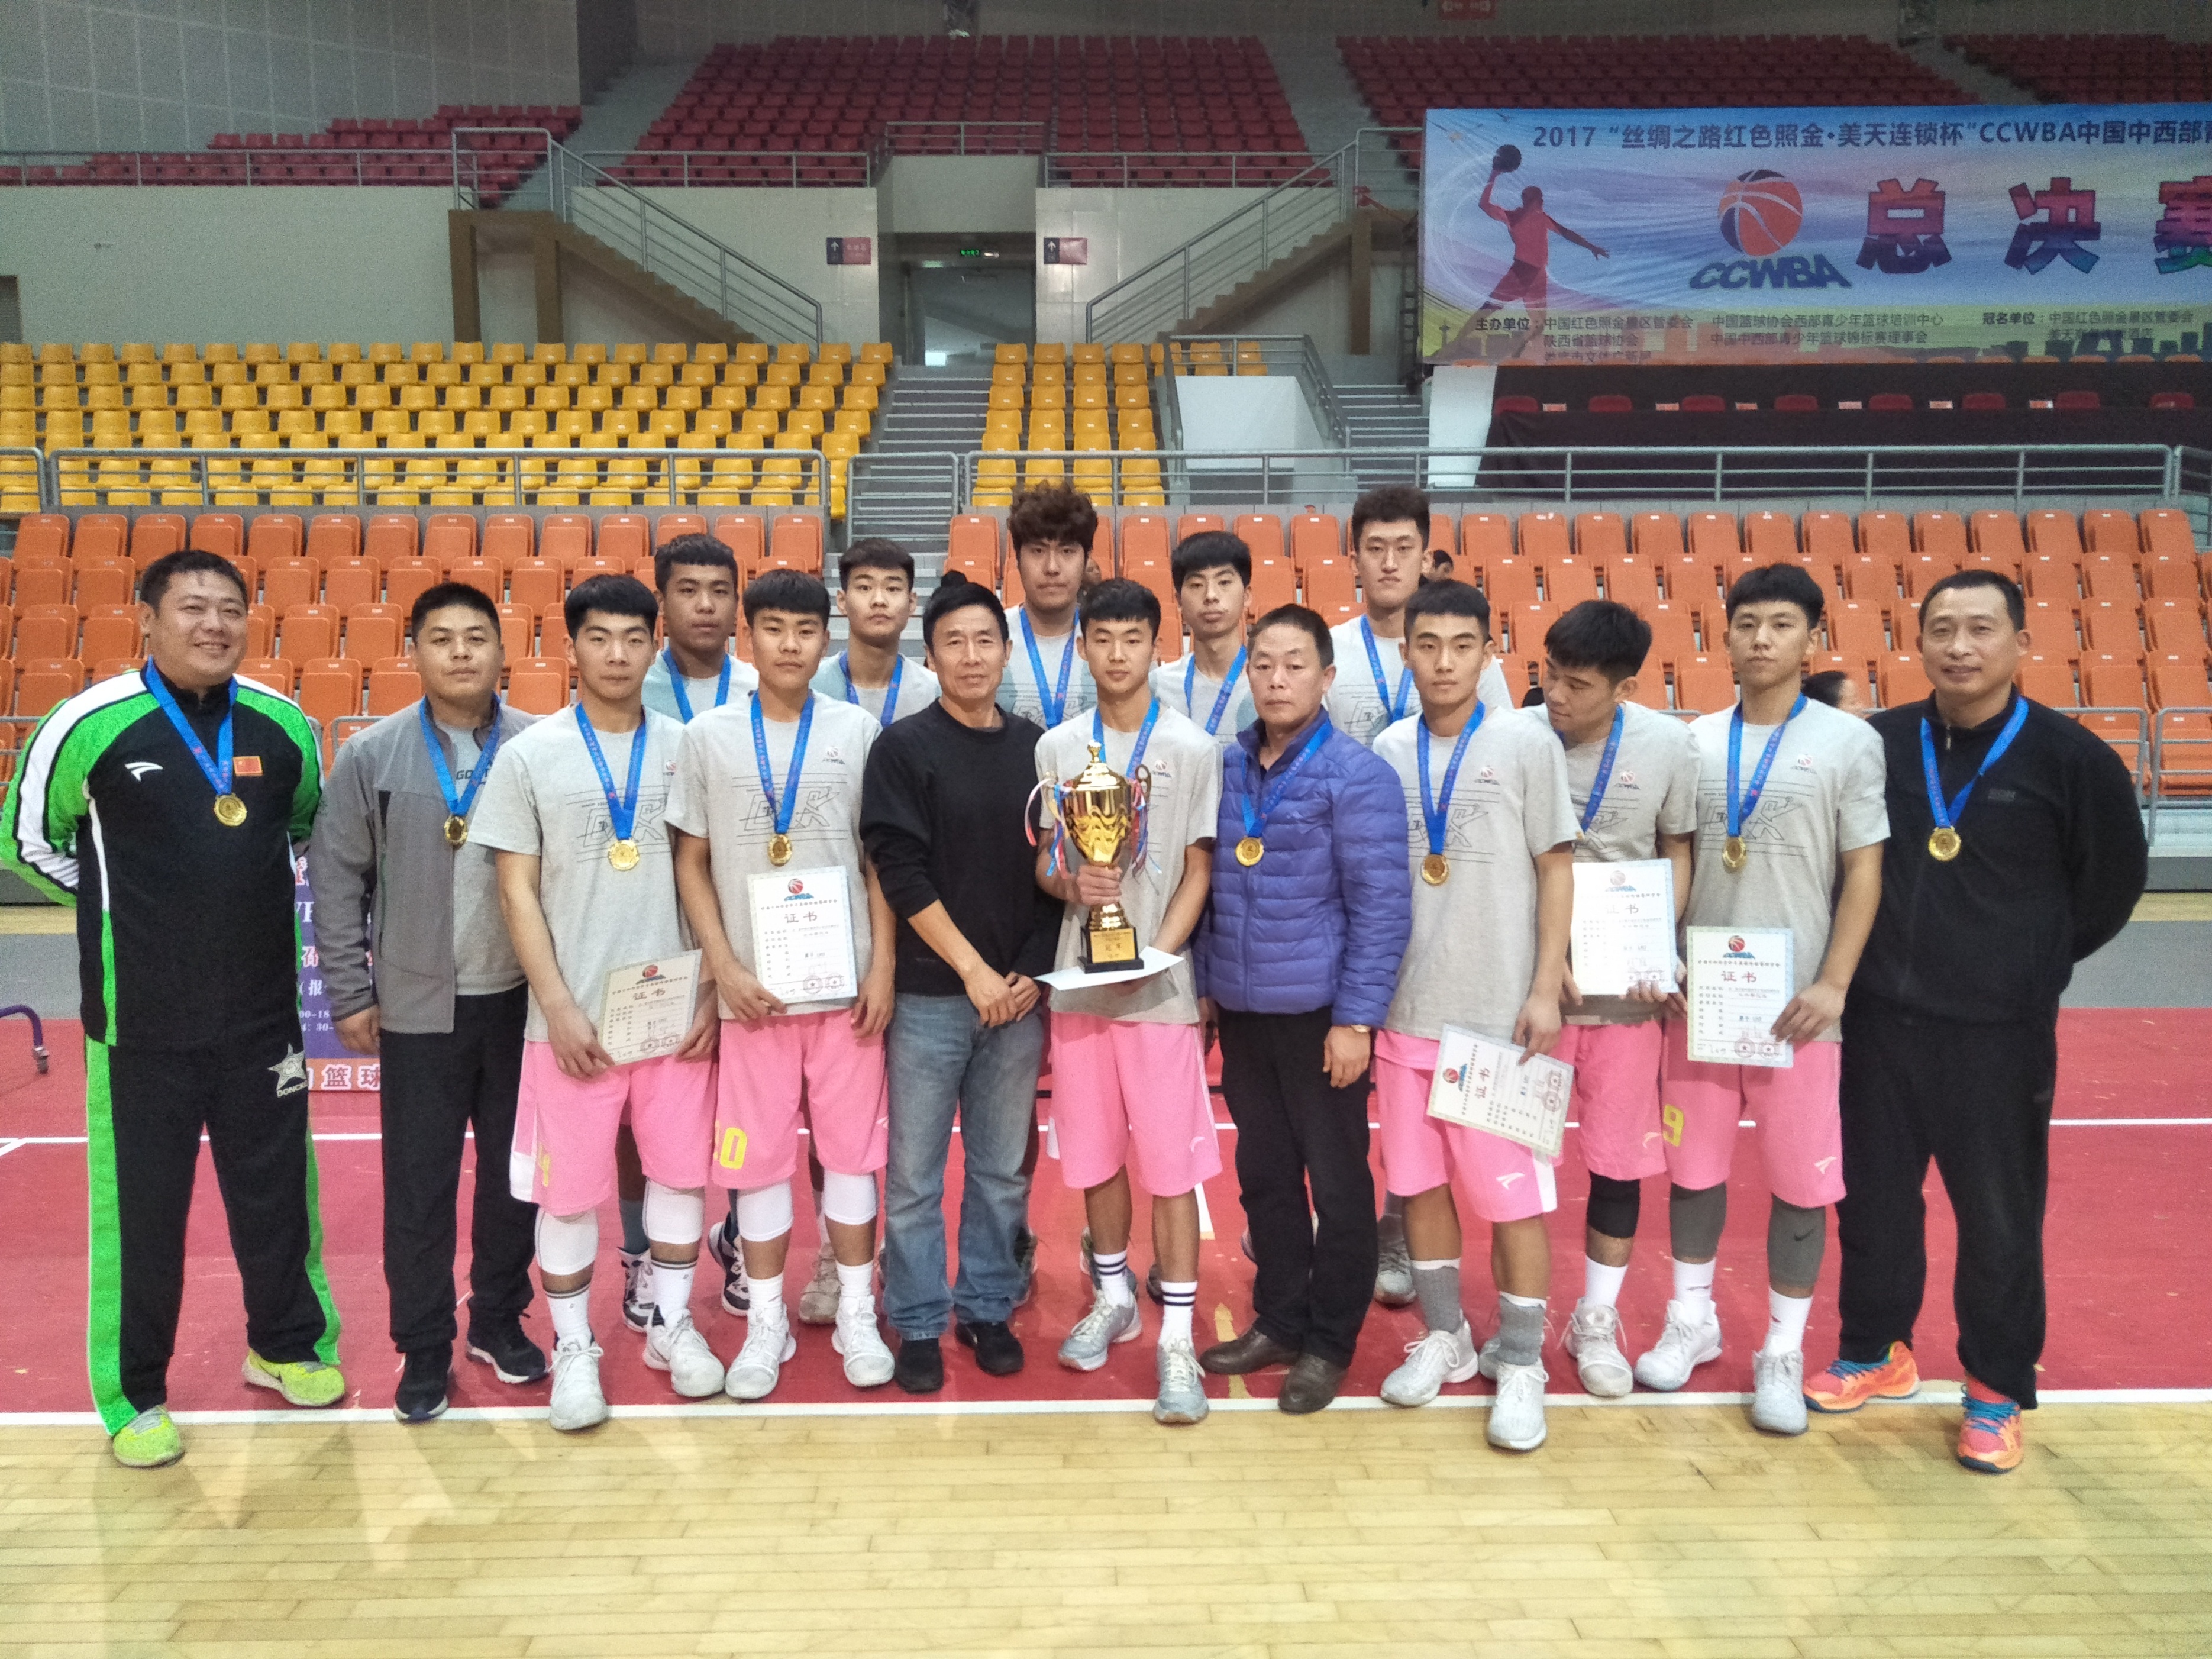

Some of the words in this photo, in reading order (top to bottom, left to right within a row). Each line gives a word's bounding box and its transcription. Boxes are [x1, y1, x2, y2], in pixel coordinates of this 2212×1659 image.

[1532, 126, 1596, 147] 2017
[1689, 254, 1852, 290] CCWBA
[784, 911, 818, 924] 证书
[1720, 970, 1757, 983] 证书
[633, 987, 666, 1001] 证书
[1474, 1067, 1491, 1099] 证书
